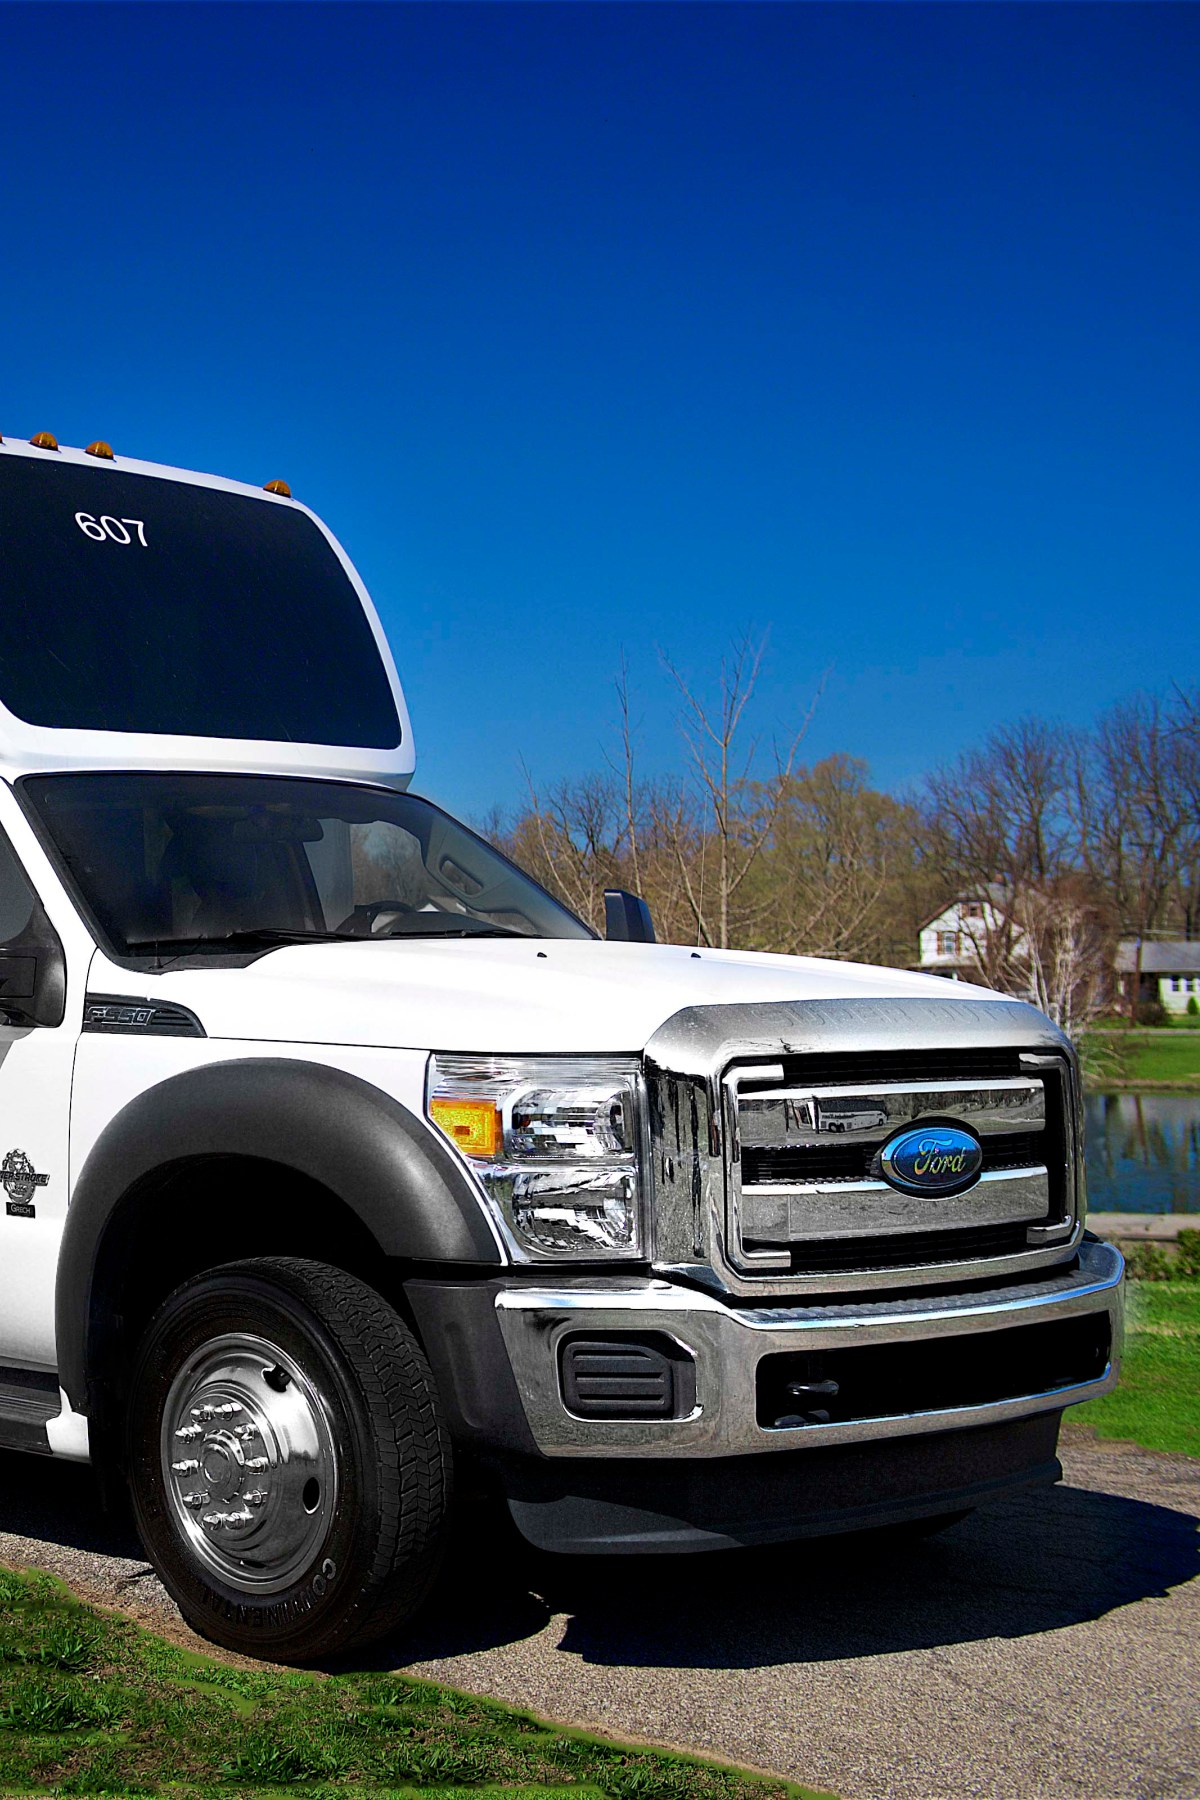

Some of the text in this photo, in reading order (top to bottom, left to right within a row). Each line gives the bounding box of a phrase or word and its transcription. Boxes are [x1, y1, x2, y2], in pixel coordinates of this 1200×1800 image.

[75, 511, 149, 547] 607
[914, 1138, 967, 1175] Ford
[15, 1171, 48, 1183] STROKE
